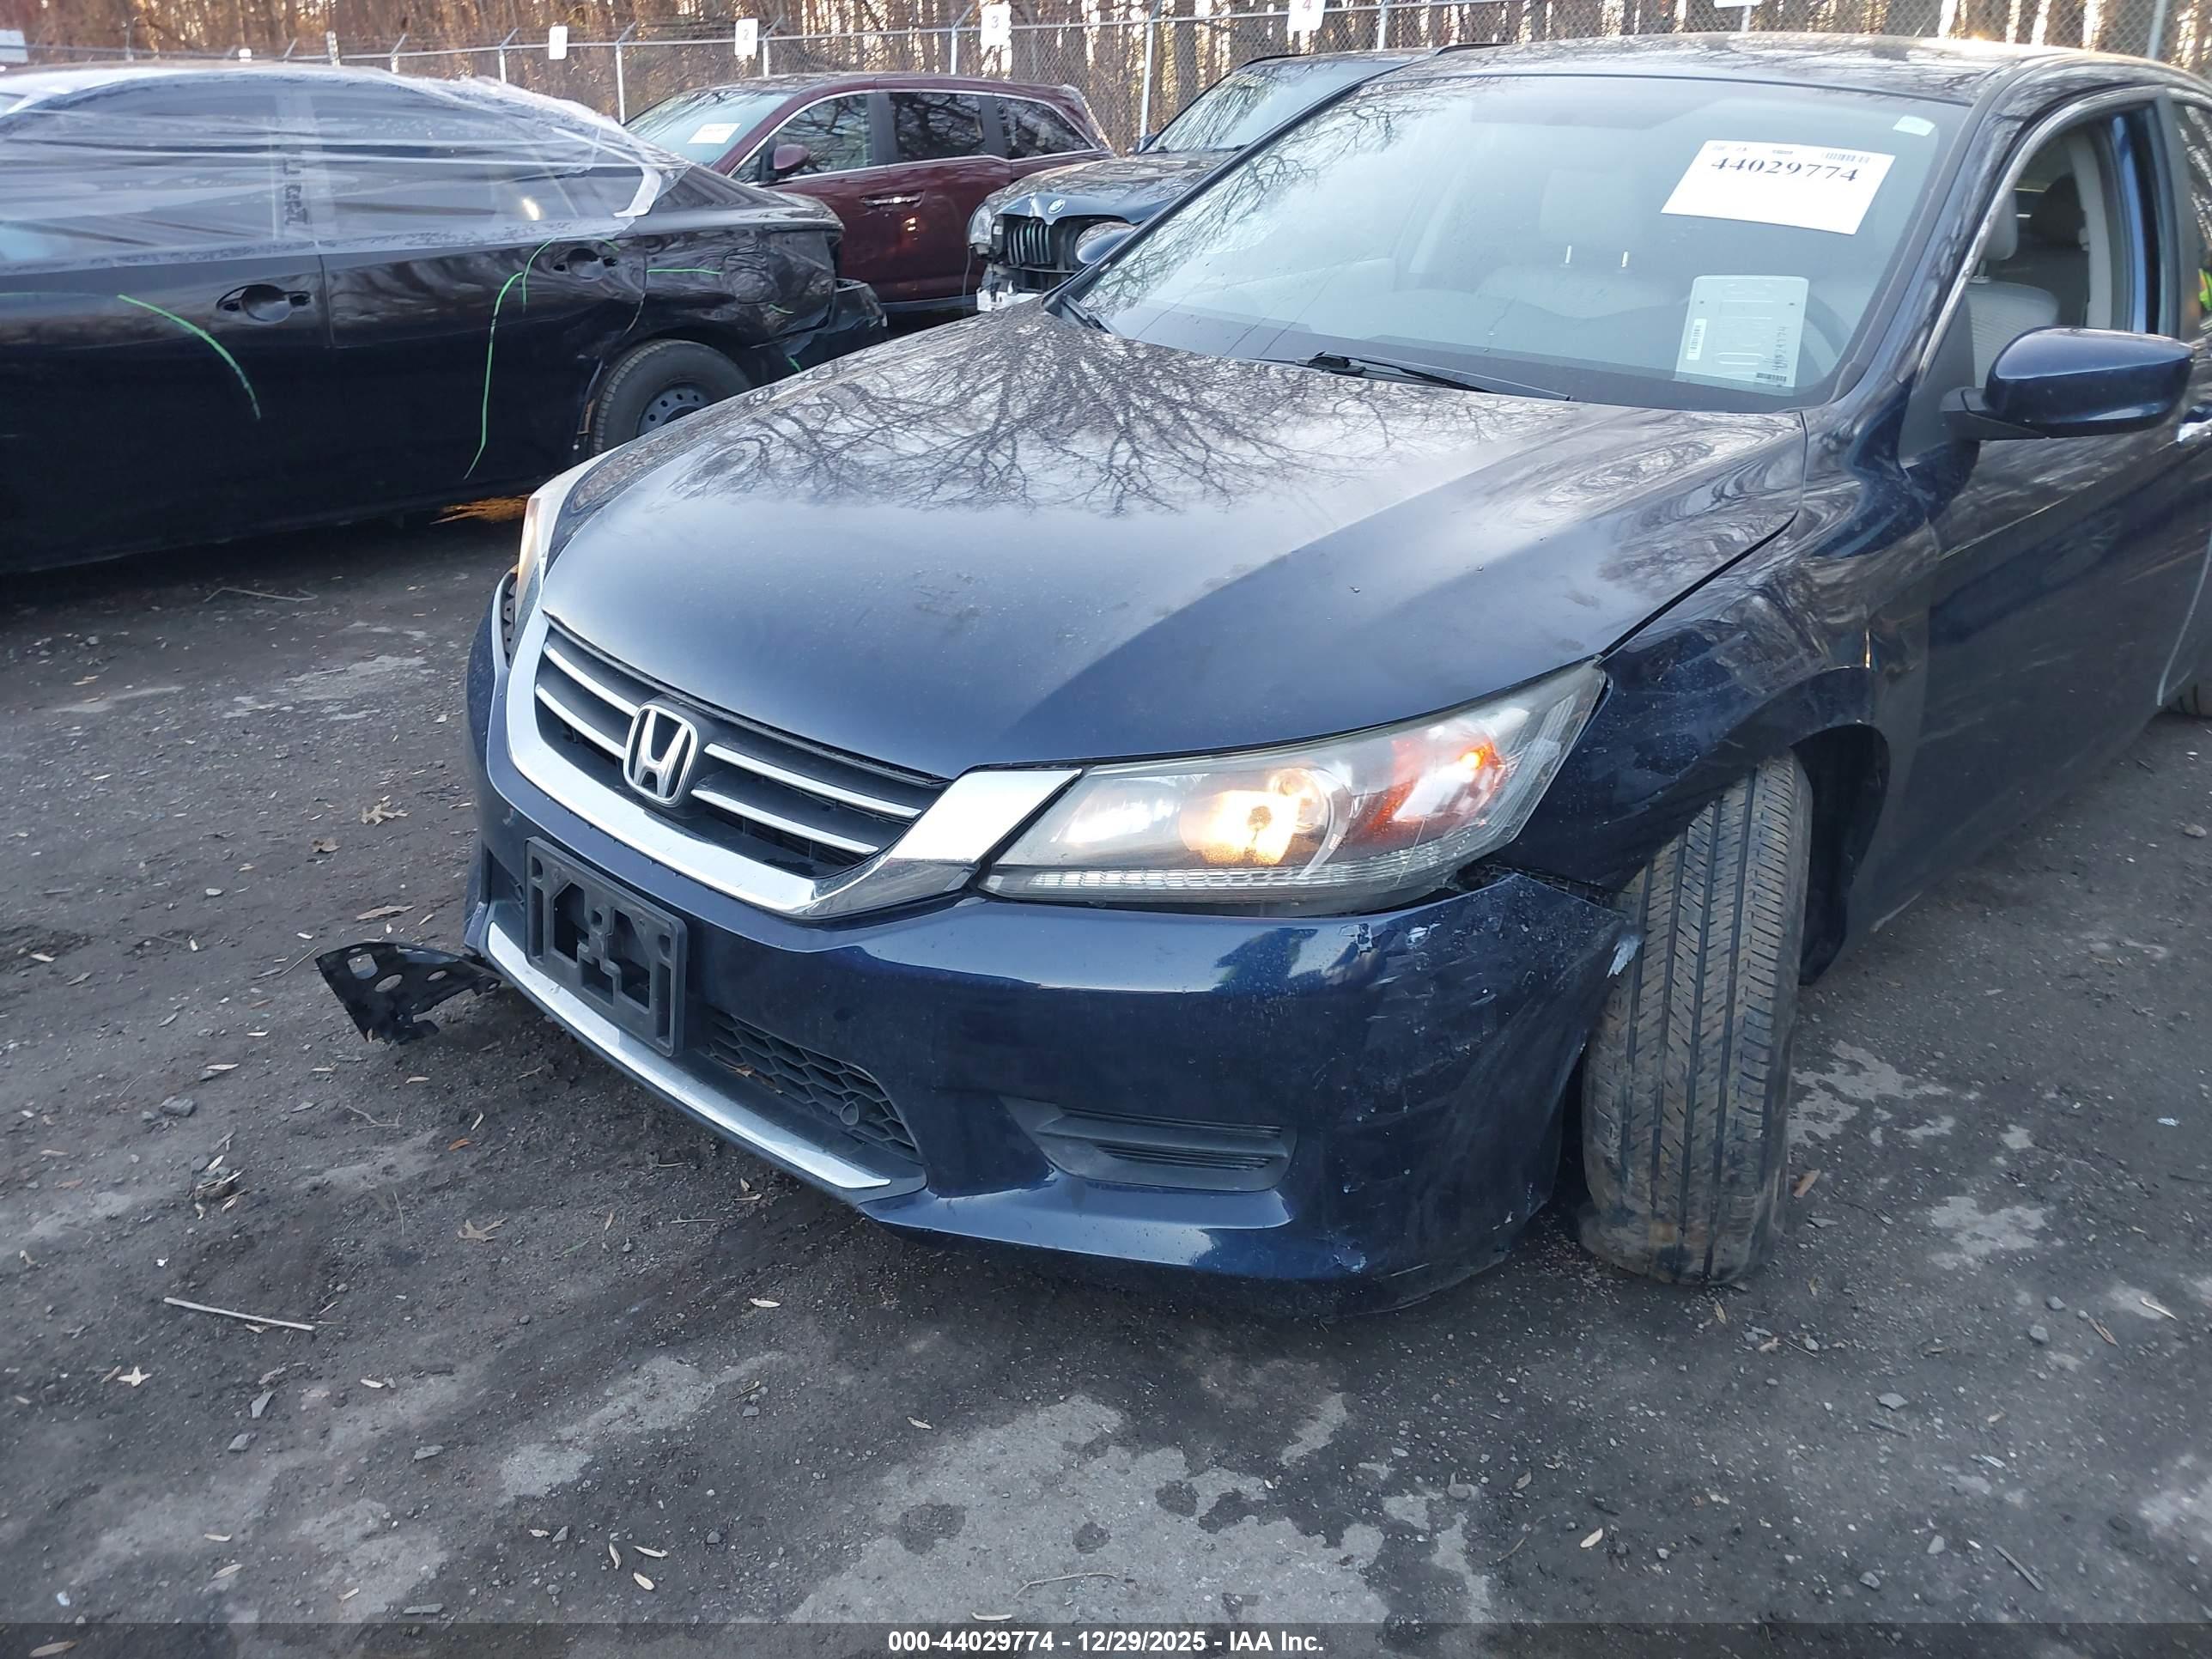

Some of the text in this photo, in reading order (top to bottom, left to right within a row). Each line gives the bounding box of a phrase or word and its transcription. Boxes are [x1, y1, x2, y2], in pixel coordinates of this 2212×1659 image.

[991, 15, 999, 28] 3
[743, 28, 750, 40] 2
[1711, 157, 1859, 182] 44029774
